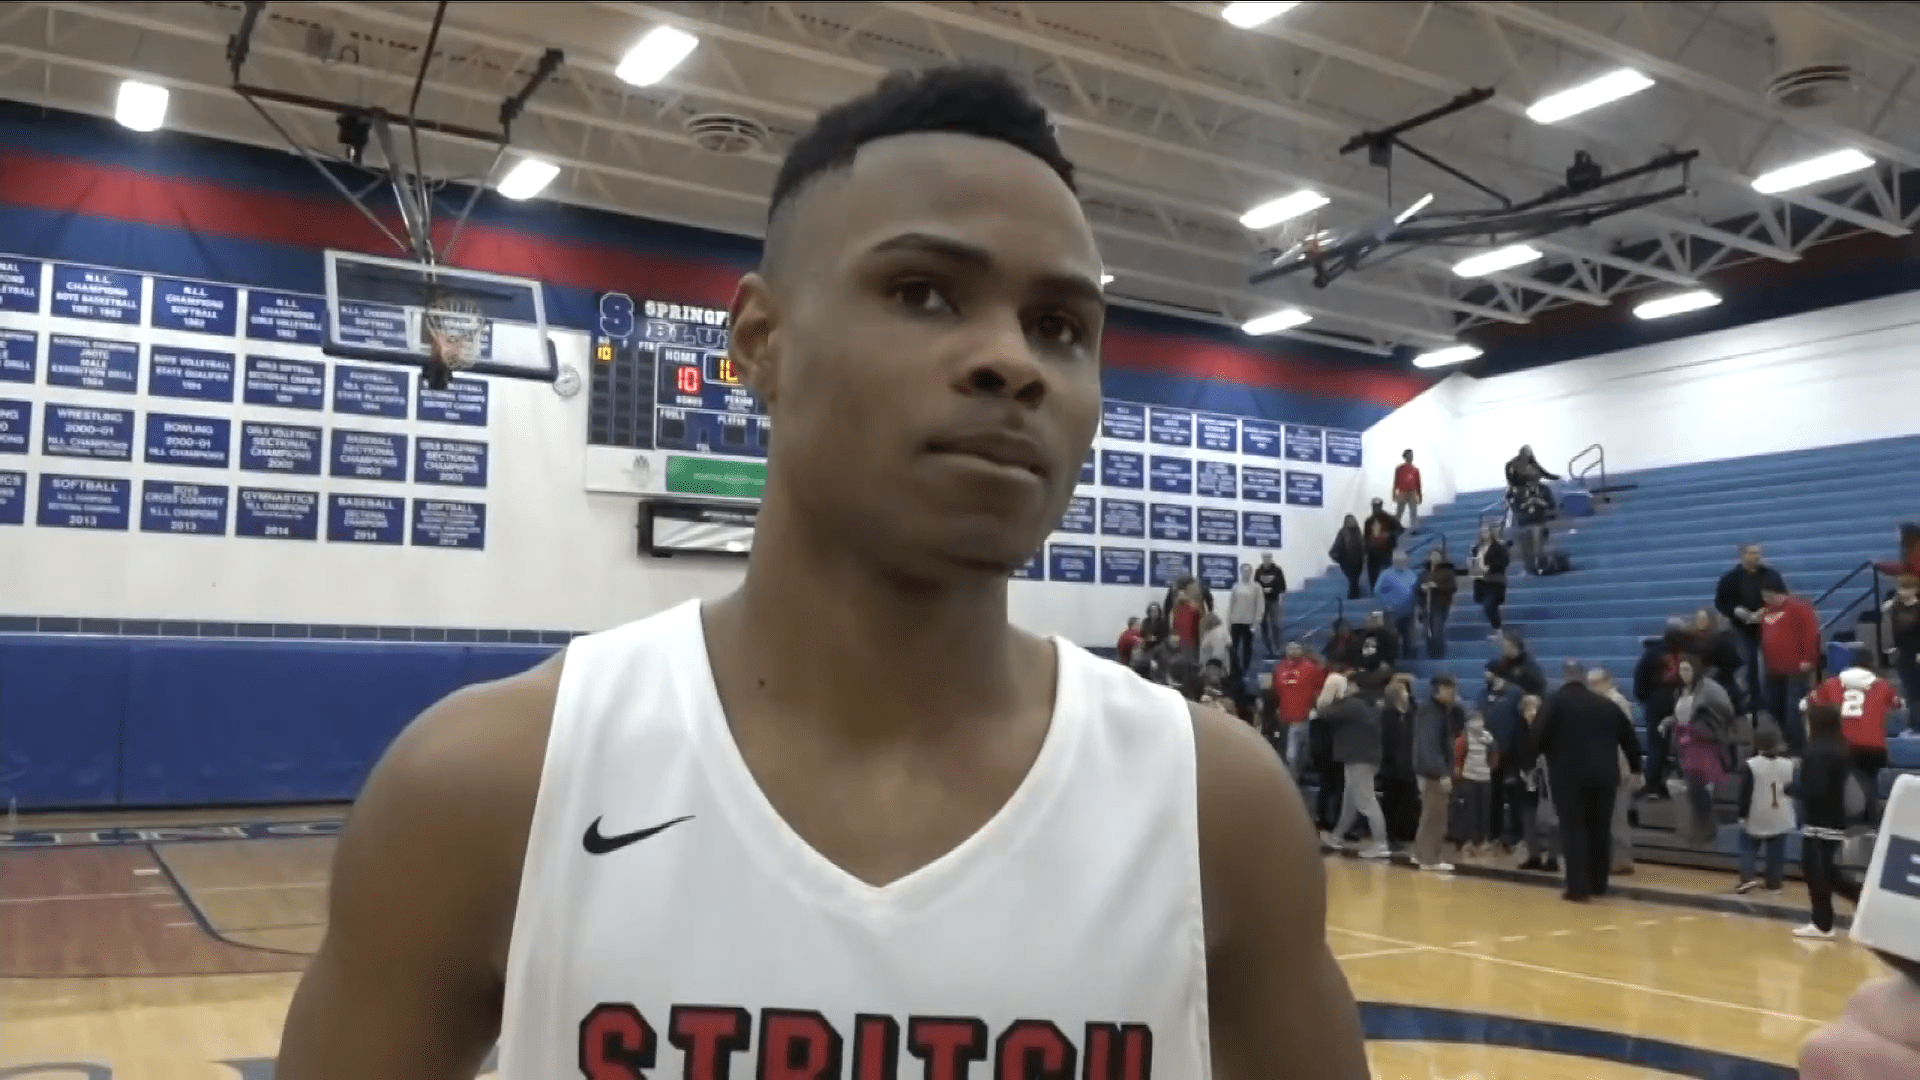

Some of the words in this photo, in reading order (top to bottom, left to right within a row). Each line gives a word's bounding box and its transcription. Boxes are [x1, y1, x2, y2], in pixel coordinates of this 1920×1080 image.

[66, 282, 129, 296] CHAMPIONS
[81, 294, 138, 310] BASKETBALL
[165, 294, 224, 310] CHAMPIONS
[171, 305, 218, 319] SOFTBALL
[260, 306, 316, 320] CHAMPIONS
[179, 356, 230, 371] VOLLEYBALL
[665, 350, 698, 363] HOME
[677, 366, 699, 392] 10
[57, 408, 123, 424] WRESTLING
[65, 422, 115, 437] 2000-01
[164, 421, 214, 435] BOWLING
[165, 436, 212, 449] 2000-01
[252, 436, 310, 450] SECTIONAL
[342, 443, 396, 457] SECTIONAL
[250, 447, 313, 462] CHAMPIONS
[339, 453, 398, 468] CHAMPIONS
[425, 450, 477, 463] SECTIONAL
[423, 460, 480, 475] CHAMPIONS
[52, 477, 119, 492] SOFTBALL
[242, 490, 316, 505] GYMNASTICS
[338, 497, 397, 511] BASEBALL
[1841, 689, 1865, 717] 2
[1769, 781, 1779, 809] 1
